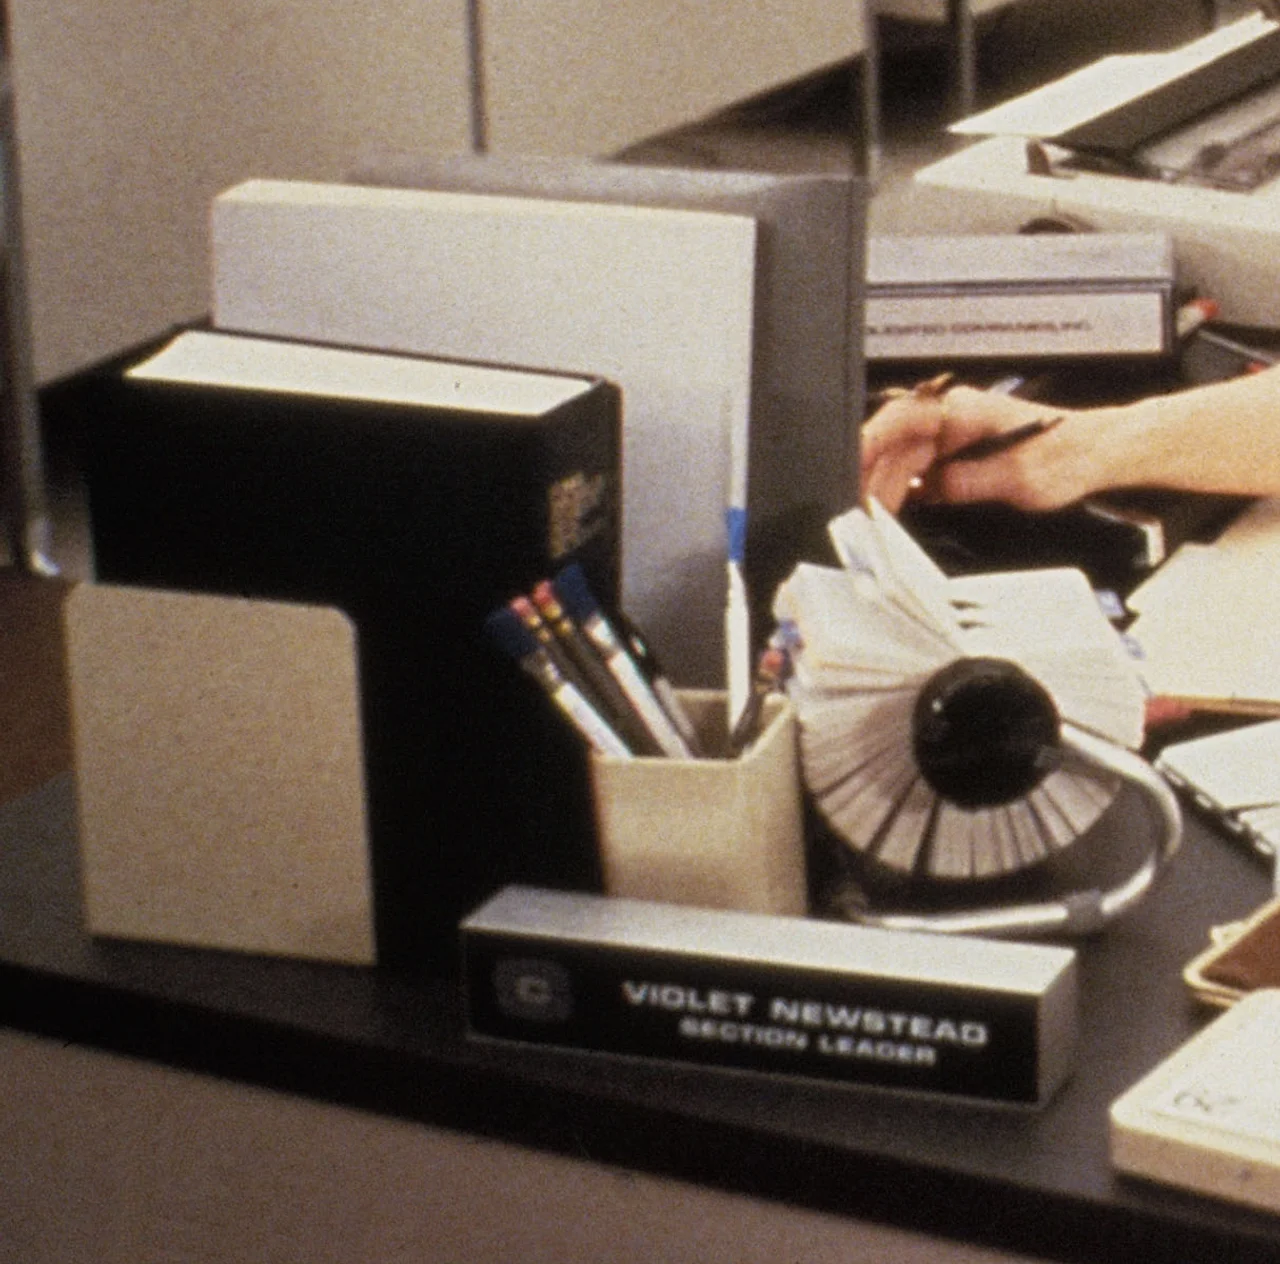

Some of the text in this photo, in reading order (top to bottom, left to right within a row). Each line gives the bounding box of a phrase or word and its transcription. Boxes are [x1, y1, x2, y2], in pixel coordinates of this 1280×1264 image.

[621, 980, 989, 1047] VIOLET NEWSTEAD
[678, 1016, 938, 1067] SECTION LEADER
